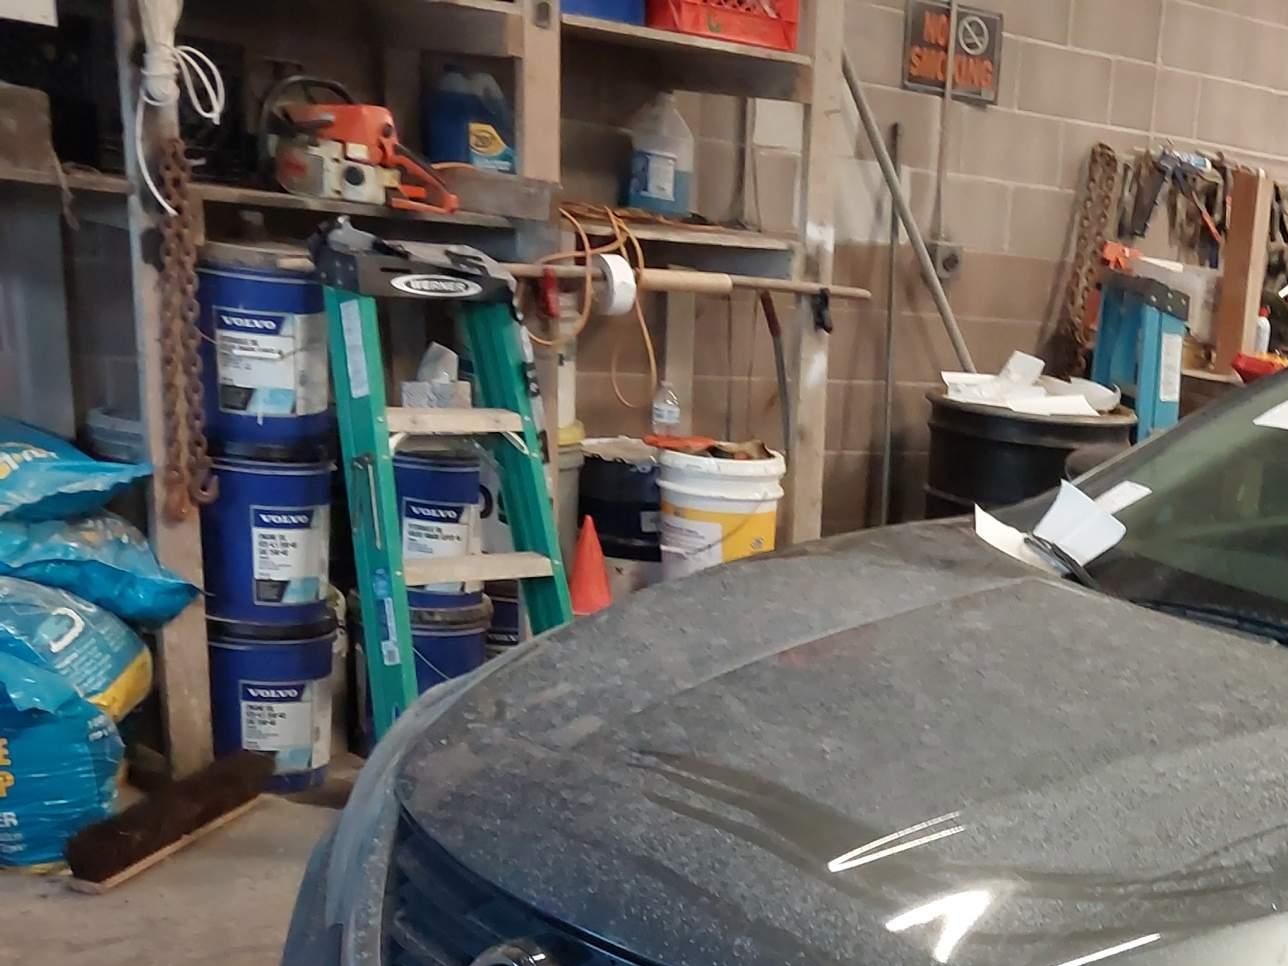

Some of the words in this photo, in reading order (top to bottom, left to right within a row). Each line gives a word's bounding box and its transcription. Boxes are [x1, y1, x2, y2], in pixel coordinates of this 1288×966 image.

[923, 9, 949, 47] NO
[910, 46, 993, 88] SMOING
[407, 278, 469, 293] WERNER
[220, 314, 277, 330] VOLVO
[258, 512, 310, 524] VOLVO
[408, 504, 459, 519] VOLVO
[246, 686, 299, 698] VOLVO
